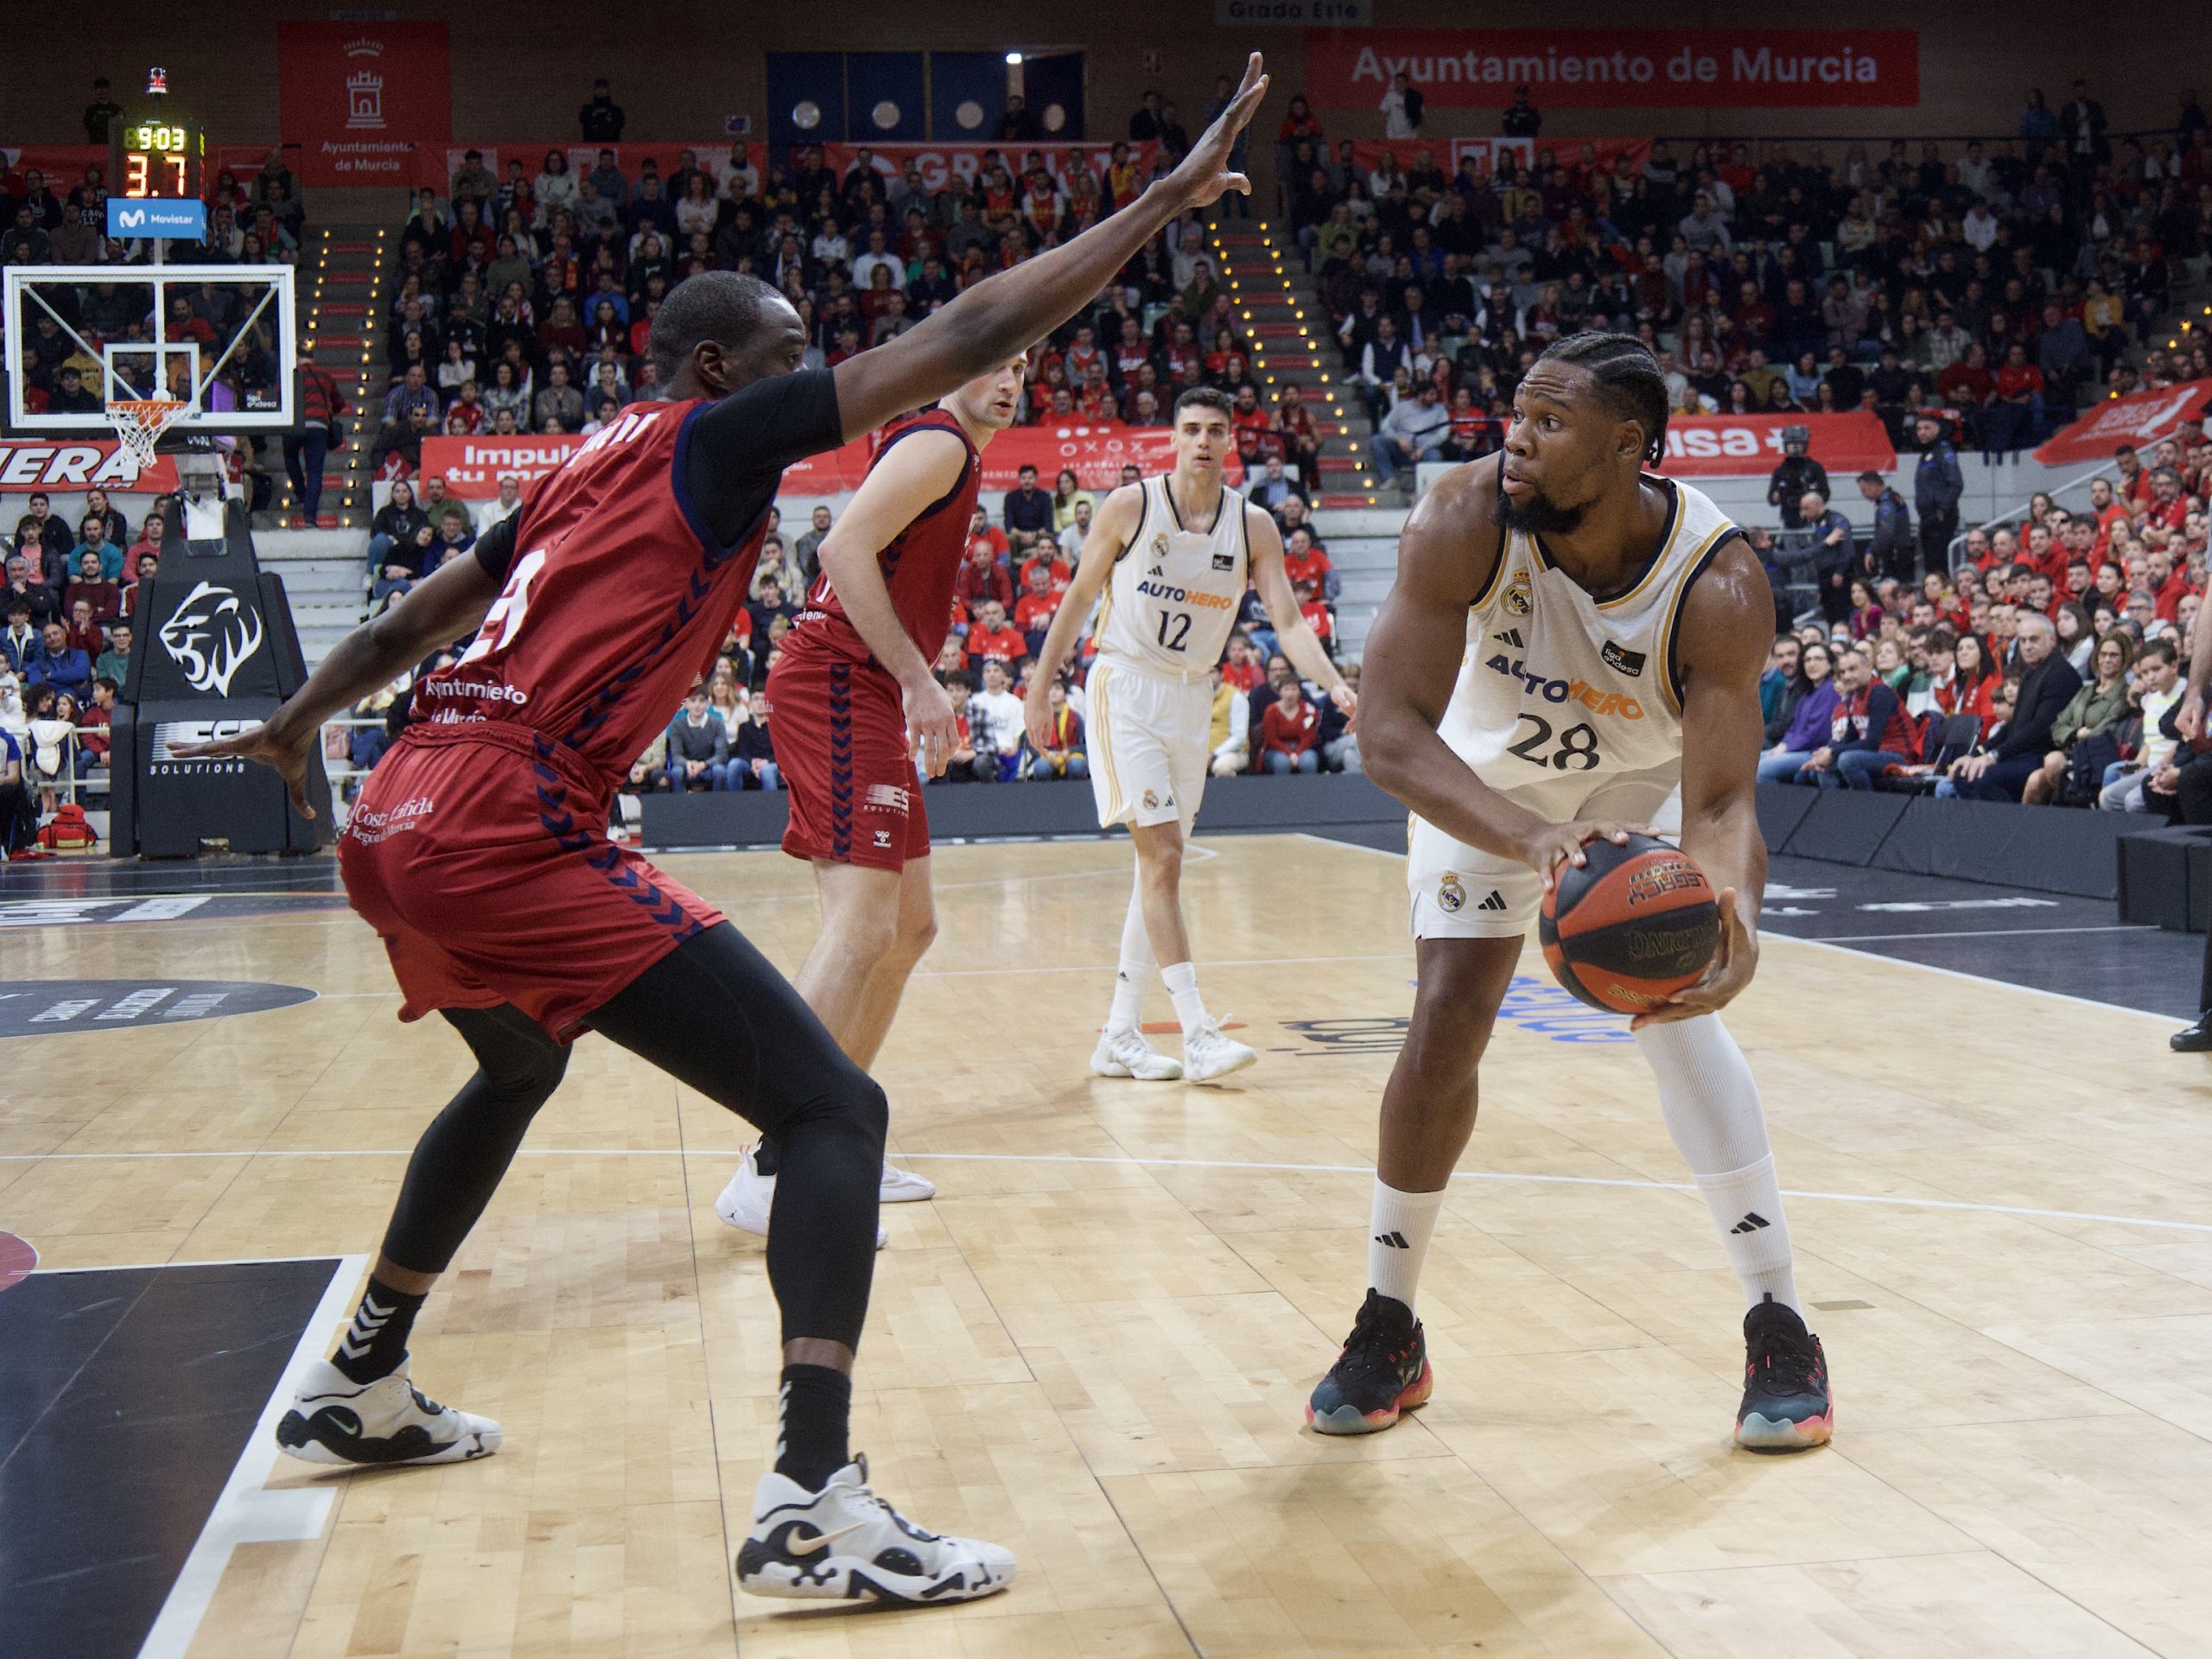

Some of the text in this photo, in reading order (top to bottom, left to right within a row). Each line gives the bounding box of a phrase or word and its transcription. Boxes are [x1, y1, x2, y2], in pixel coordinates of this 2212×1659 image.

[1230, 2, 1357, 18] Grada Este
[1351, 46, 1878, 84] Ayuntamiento de Murcia
[138, 127, 185, 149] 9:03
[321, 141, 416, 154] Ayuntamiento
[335, 159, 401, 170] de Murcia
[150, 214, 194, 224] Movistar
[1663, 429, 1759, 457] isa
[465, 444, 581, 467] Impul
[446, 467, 485, 482] tu
[1136, 580, 1233, 611] AUTOHERO
[1158, 610, 1192, 652] 12
[1604, 655, 1639, 675] endesa
[1605, 648, 1622, 662] liga
[1485, 653, 1645, 721] AUTOHERO
[1506, 712, 1600, 771] 28
[149, 763, 245, 776] SOLUTIONS
[1627, 872, 1709, 906] LEGACY
